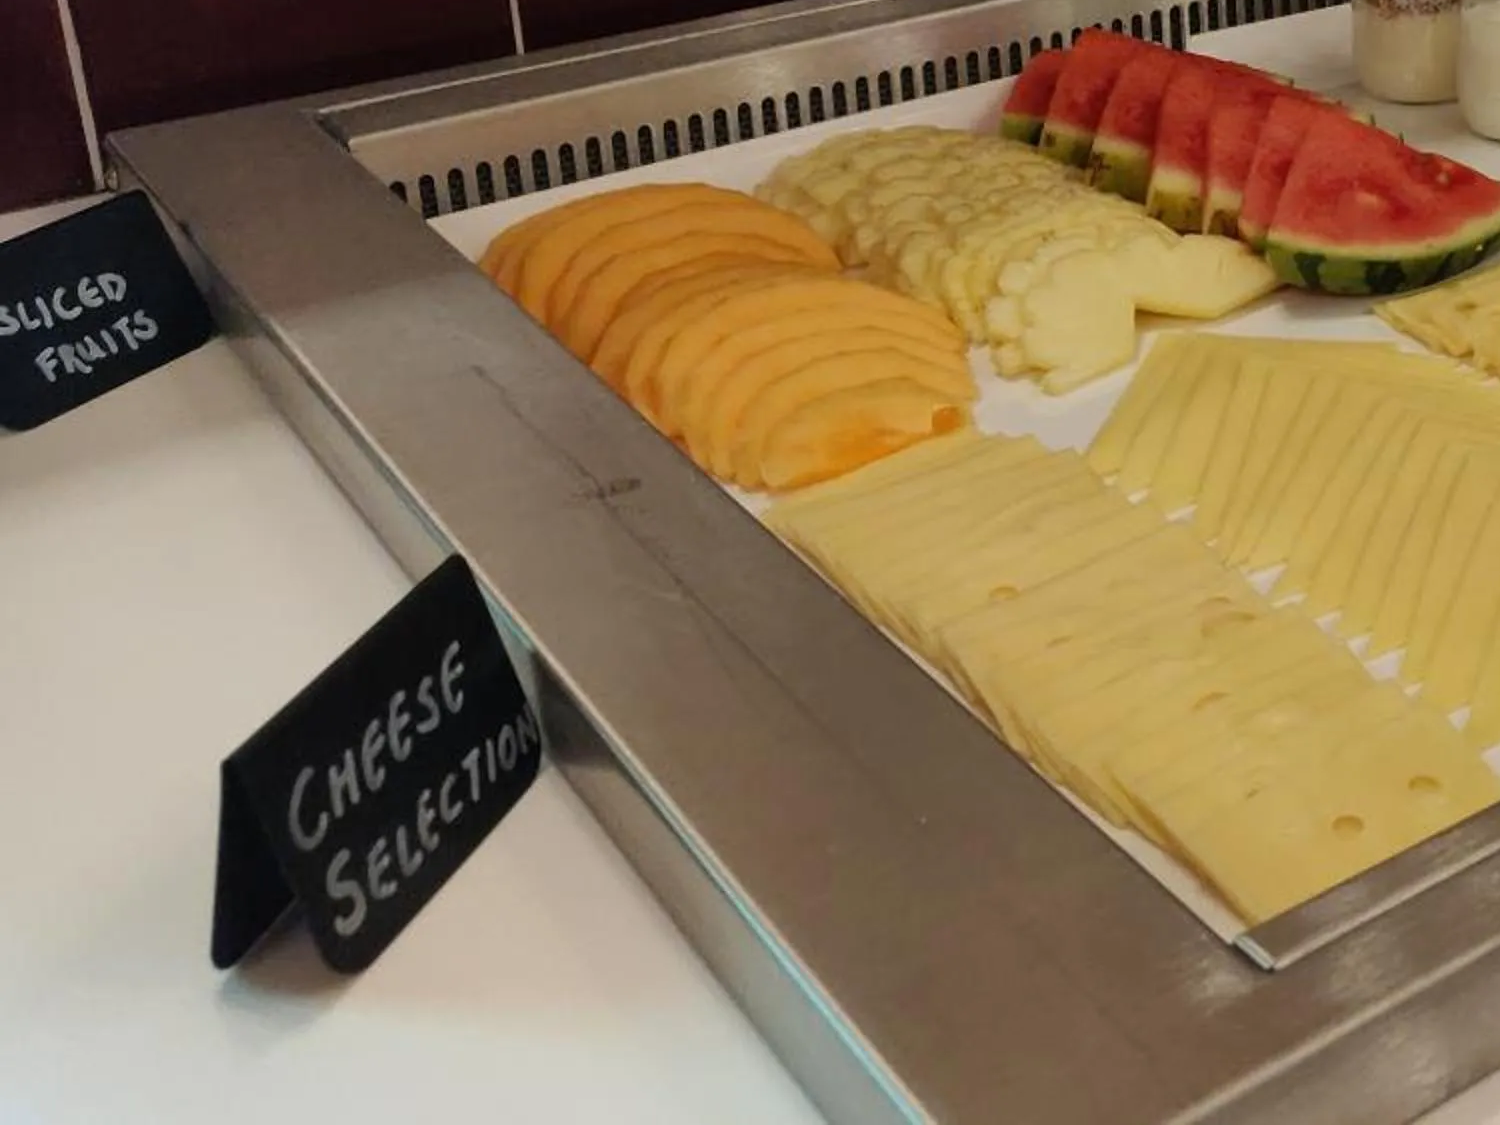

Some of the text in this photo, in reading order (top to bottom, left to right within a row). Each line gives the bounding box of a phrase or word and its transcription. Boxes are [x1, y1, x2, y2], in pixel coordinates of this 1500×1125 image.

[0, 272, 127, 336] SLICED
[34, 308, 159, 383] FRUITS
[288, 639, 464, 851] CHEESE
[325, 701, 538, 936] SELECTION
